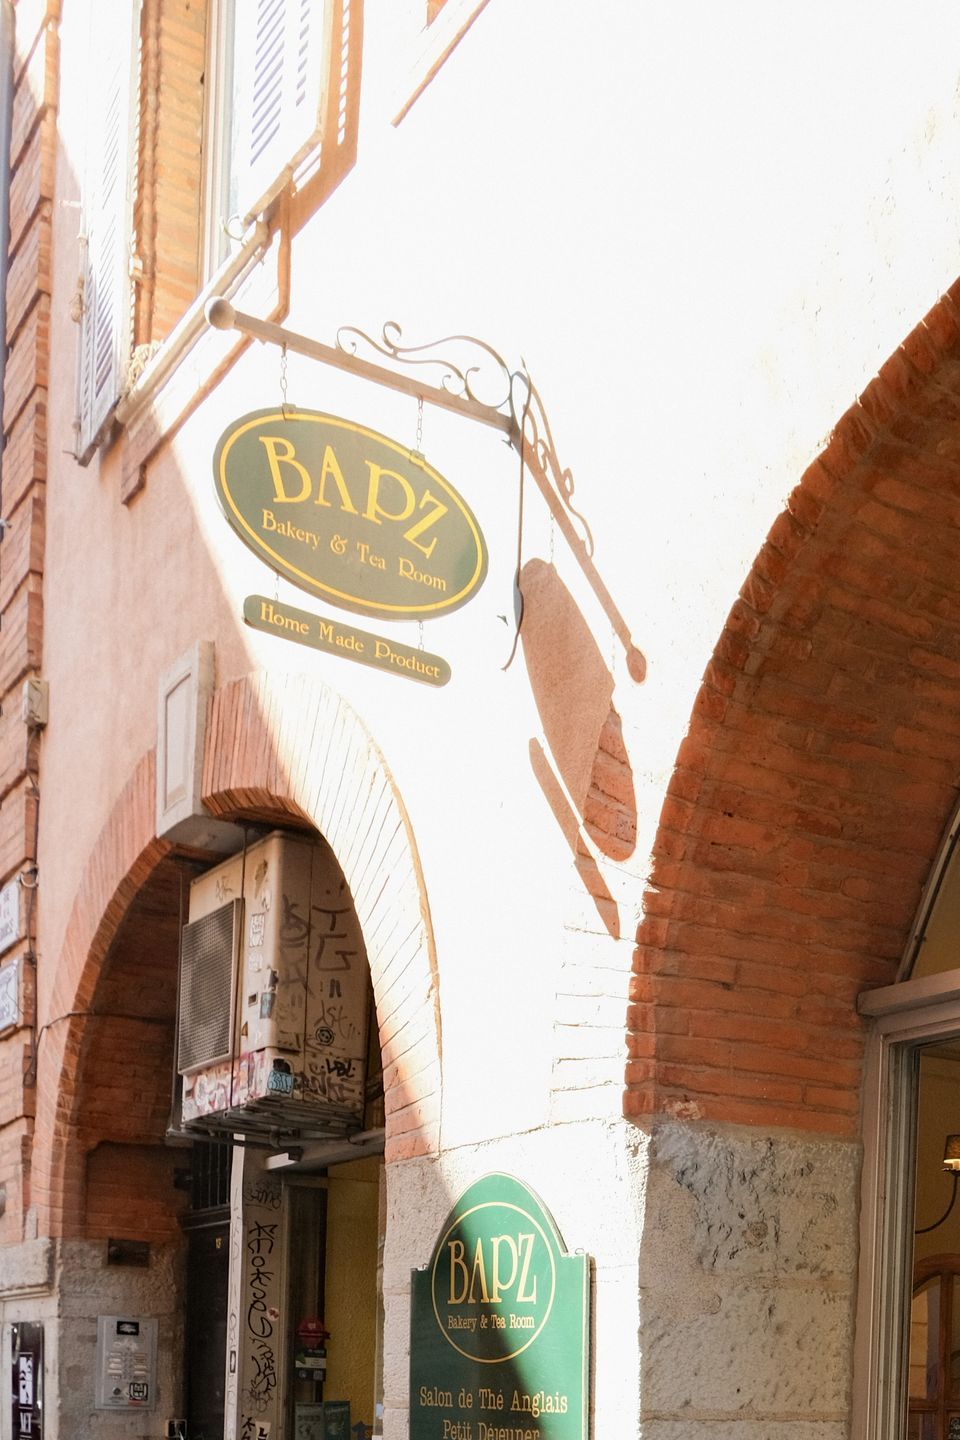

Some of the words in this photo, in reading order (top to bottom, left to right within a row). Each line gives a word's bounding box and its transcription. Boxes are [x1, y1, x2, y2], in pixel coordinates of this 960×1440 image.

[259, 436, 449, 559] BAPZ
[262, 509, 321, 550] Bakery
[330, 535, 348, 555] &
[357, 542, 387, 570] Tea
[398, 556, 447, 591] Room
[260, 602, 310, 634] Home
[319, 621, 364, 653] Made
[375, 640, 440, 678] Product
[447, 1232, 537, 1305] BAPZ
[448, 1315, 477, 1333] Bakery
[480, 1314, 488, 1329] &
[490, 1314, 506, 1329] Tea
[509, 1313, 536, 1329] Room
[420, 1386, 453, 1408] Salon
[458, 1388, 473, 1408] de
[479, 1388, 504, 1411] Thé
[510, 1390, 568, 1418] Anglais
